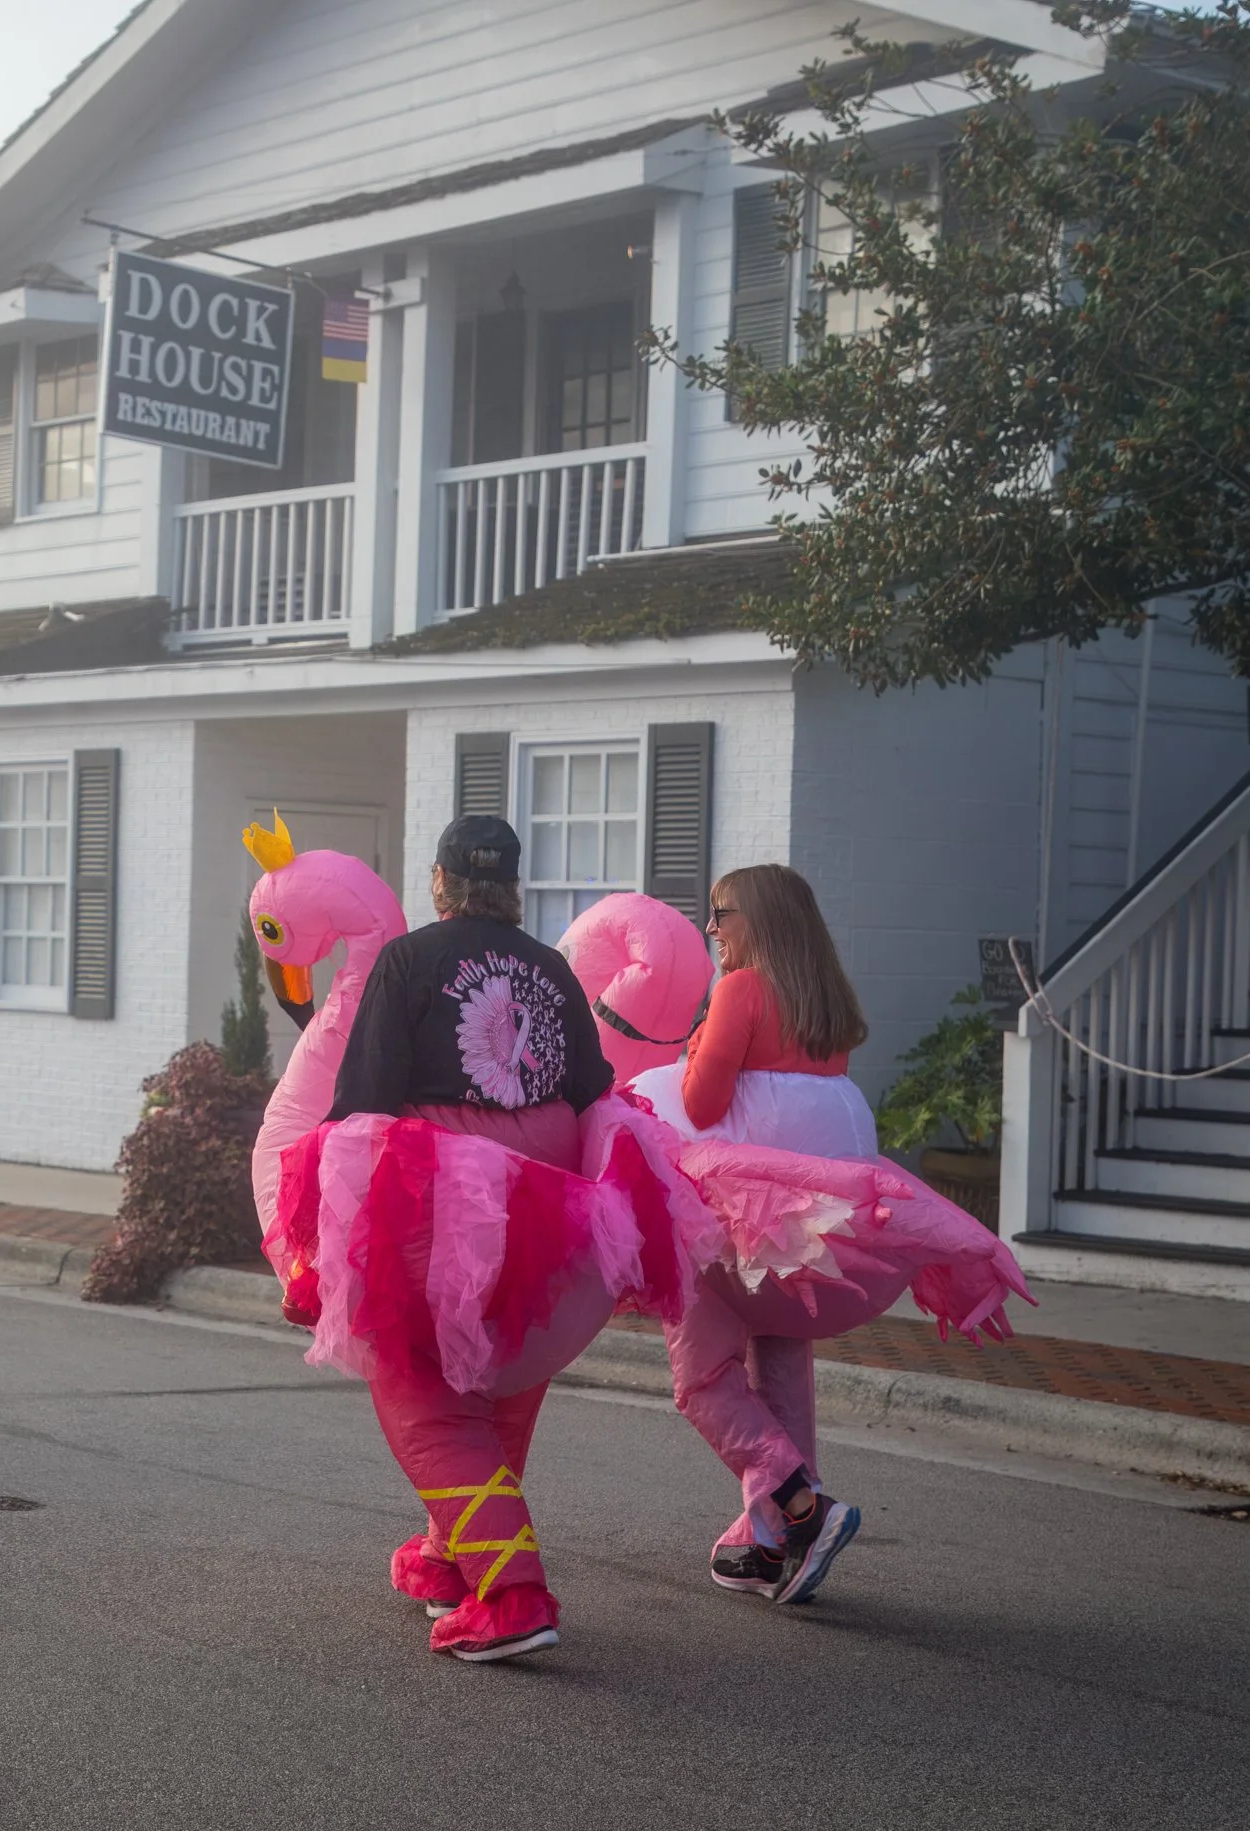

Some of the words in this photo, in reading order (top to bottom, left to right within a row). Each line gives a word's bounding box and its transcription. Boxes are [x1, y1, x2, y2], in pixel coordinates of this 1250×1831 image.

[124, 269, 279, 350] DOCK
[115, 330, 280, 410] HOUSE
[117, 392, 271, 450] RESTAURANT
[485, 950, 529, 977] Hope
